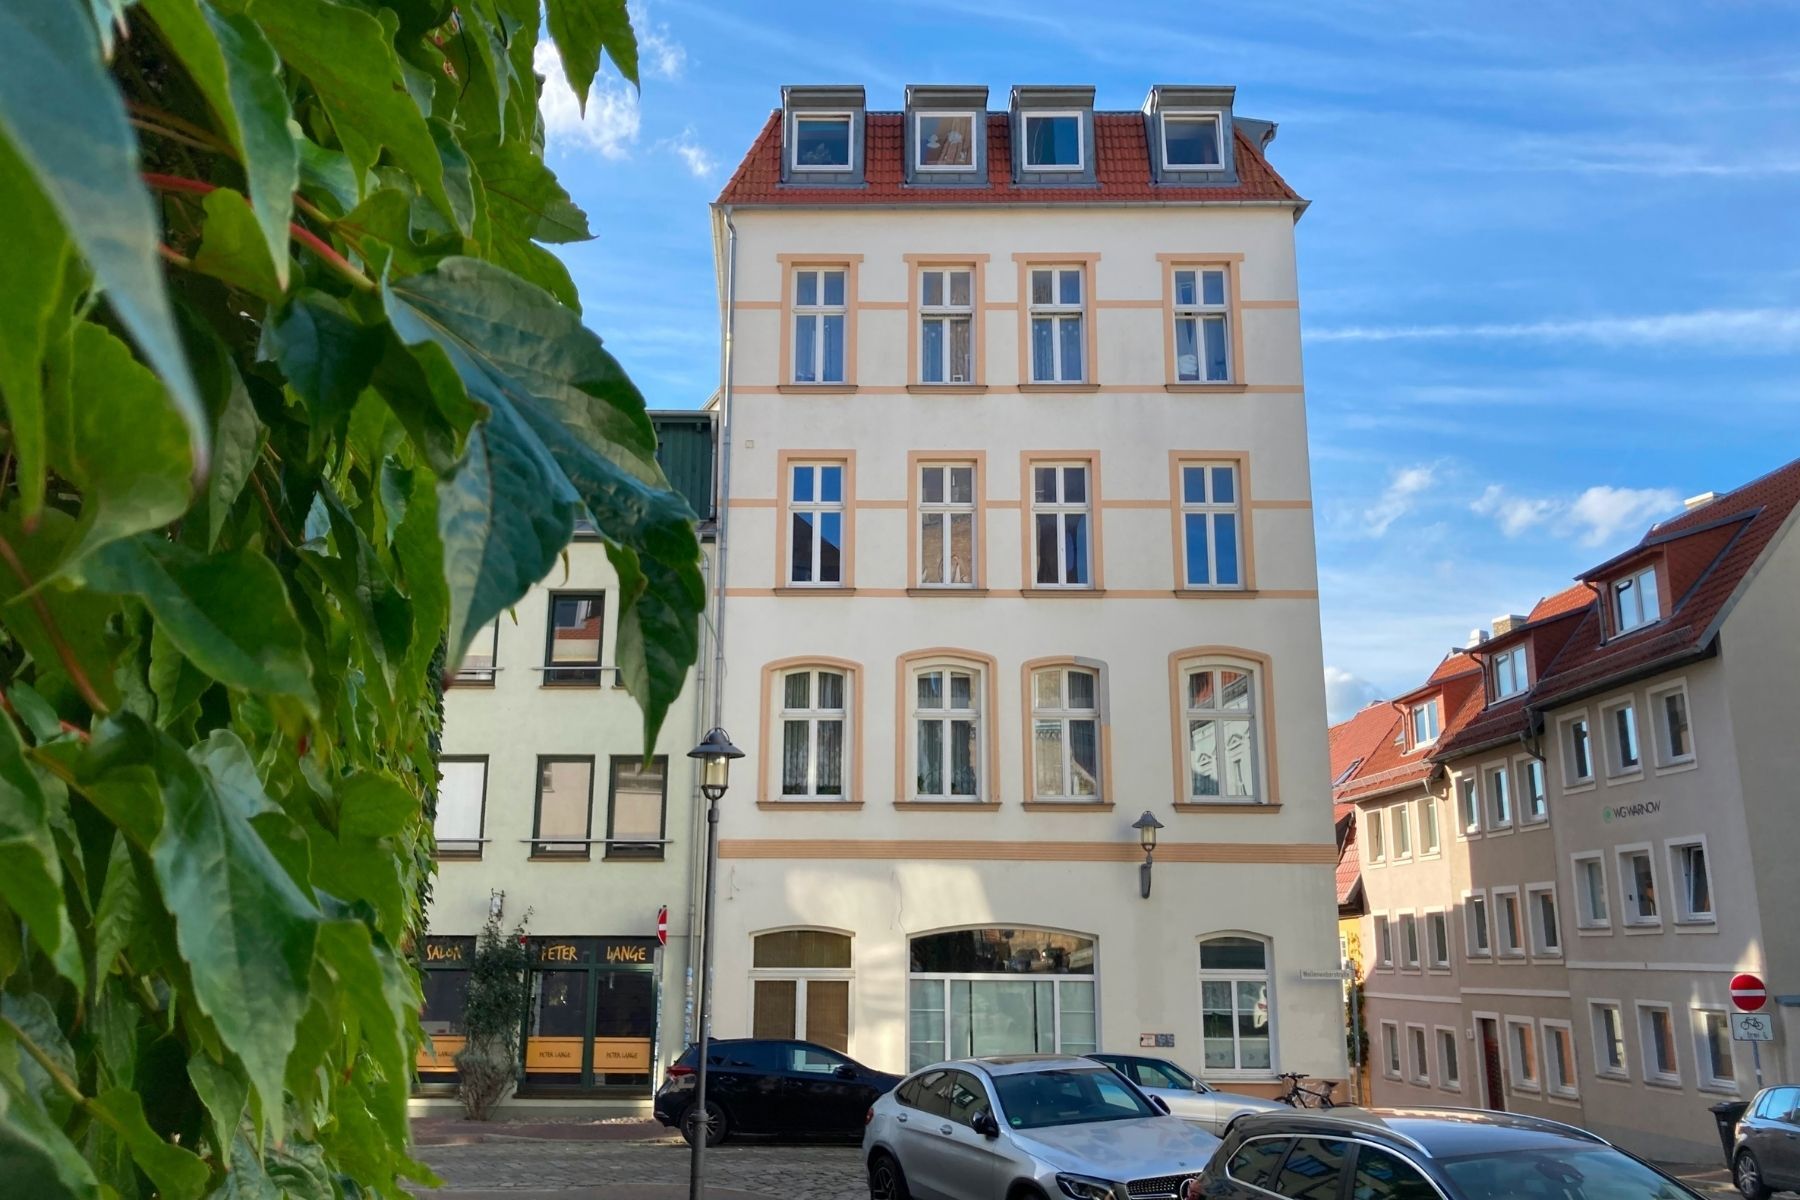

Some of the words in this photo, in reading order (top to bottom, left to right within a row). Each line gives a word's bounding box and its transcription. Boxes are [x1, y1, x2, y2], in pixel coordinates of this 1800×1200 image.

[1613, 806, 1627, 818] WG
[1628, 800, 1661, 816] WARNOW
[606, 946, 646, 961] LANGE
